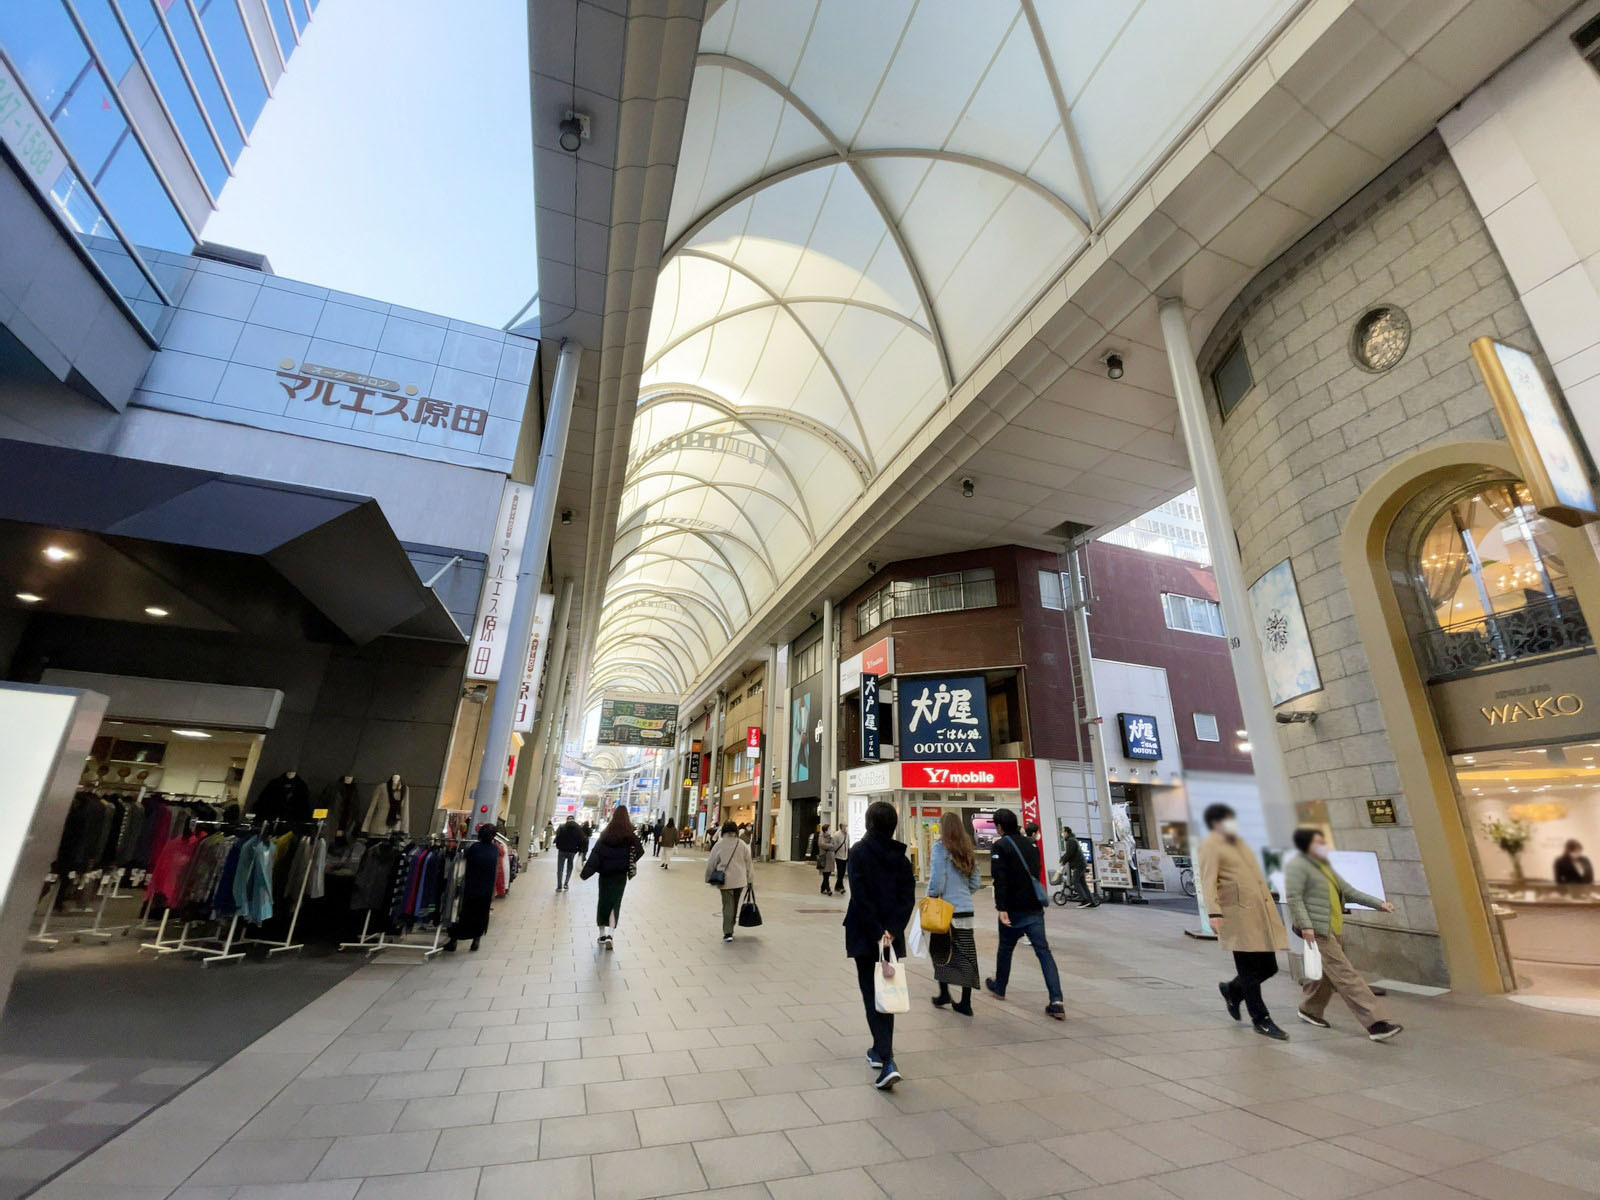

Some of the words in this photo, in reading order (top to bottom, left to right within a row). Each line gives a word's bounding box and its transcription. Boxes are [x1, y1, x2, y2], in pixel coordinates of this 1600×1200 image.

[276, 371, 488, 437] マルエス原田
[474, 547, 511, 675] マルエス原田
[864, 676, 878, 731] 大戸屋
[908, 683, 979, 733] 大戸屋
[1480, 692, 1584, 727] WAKO
[914, 742, 976, 754] OOTOYA
